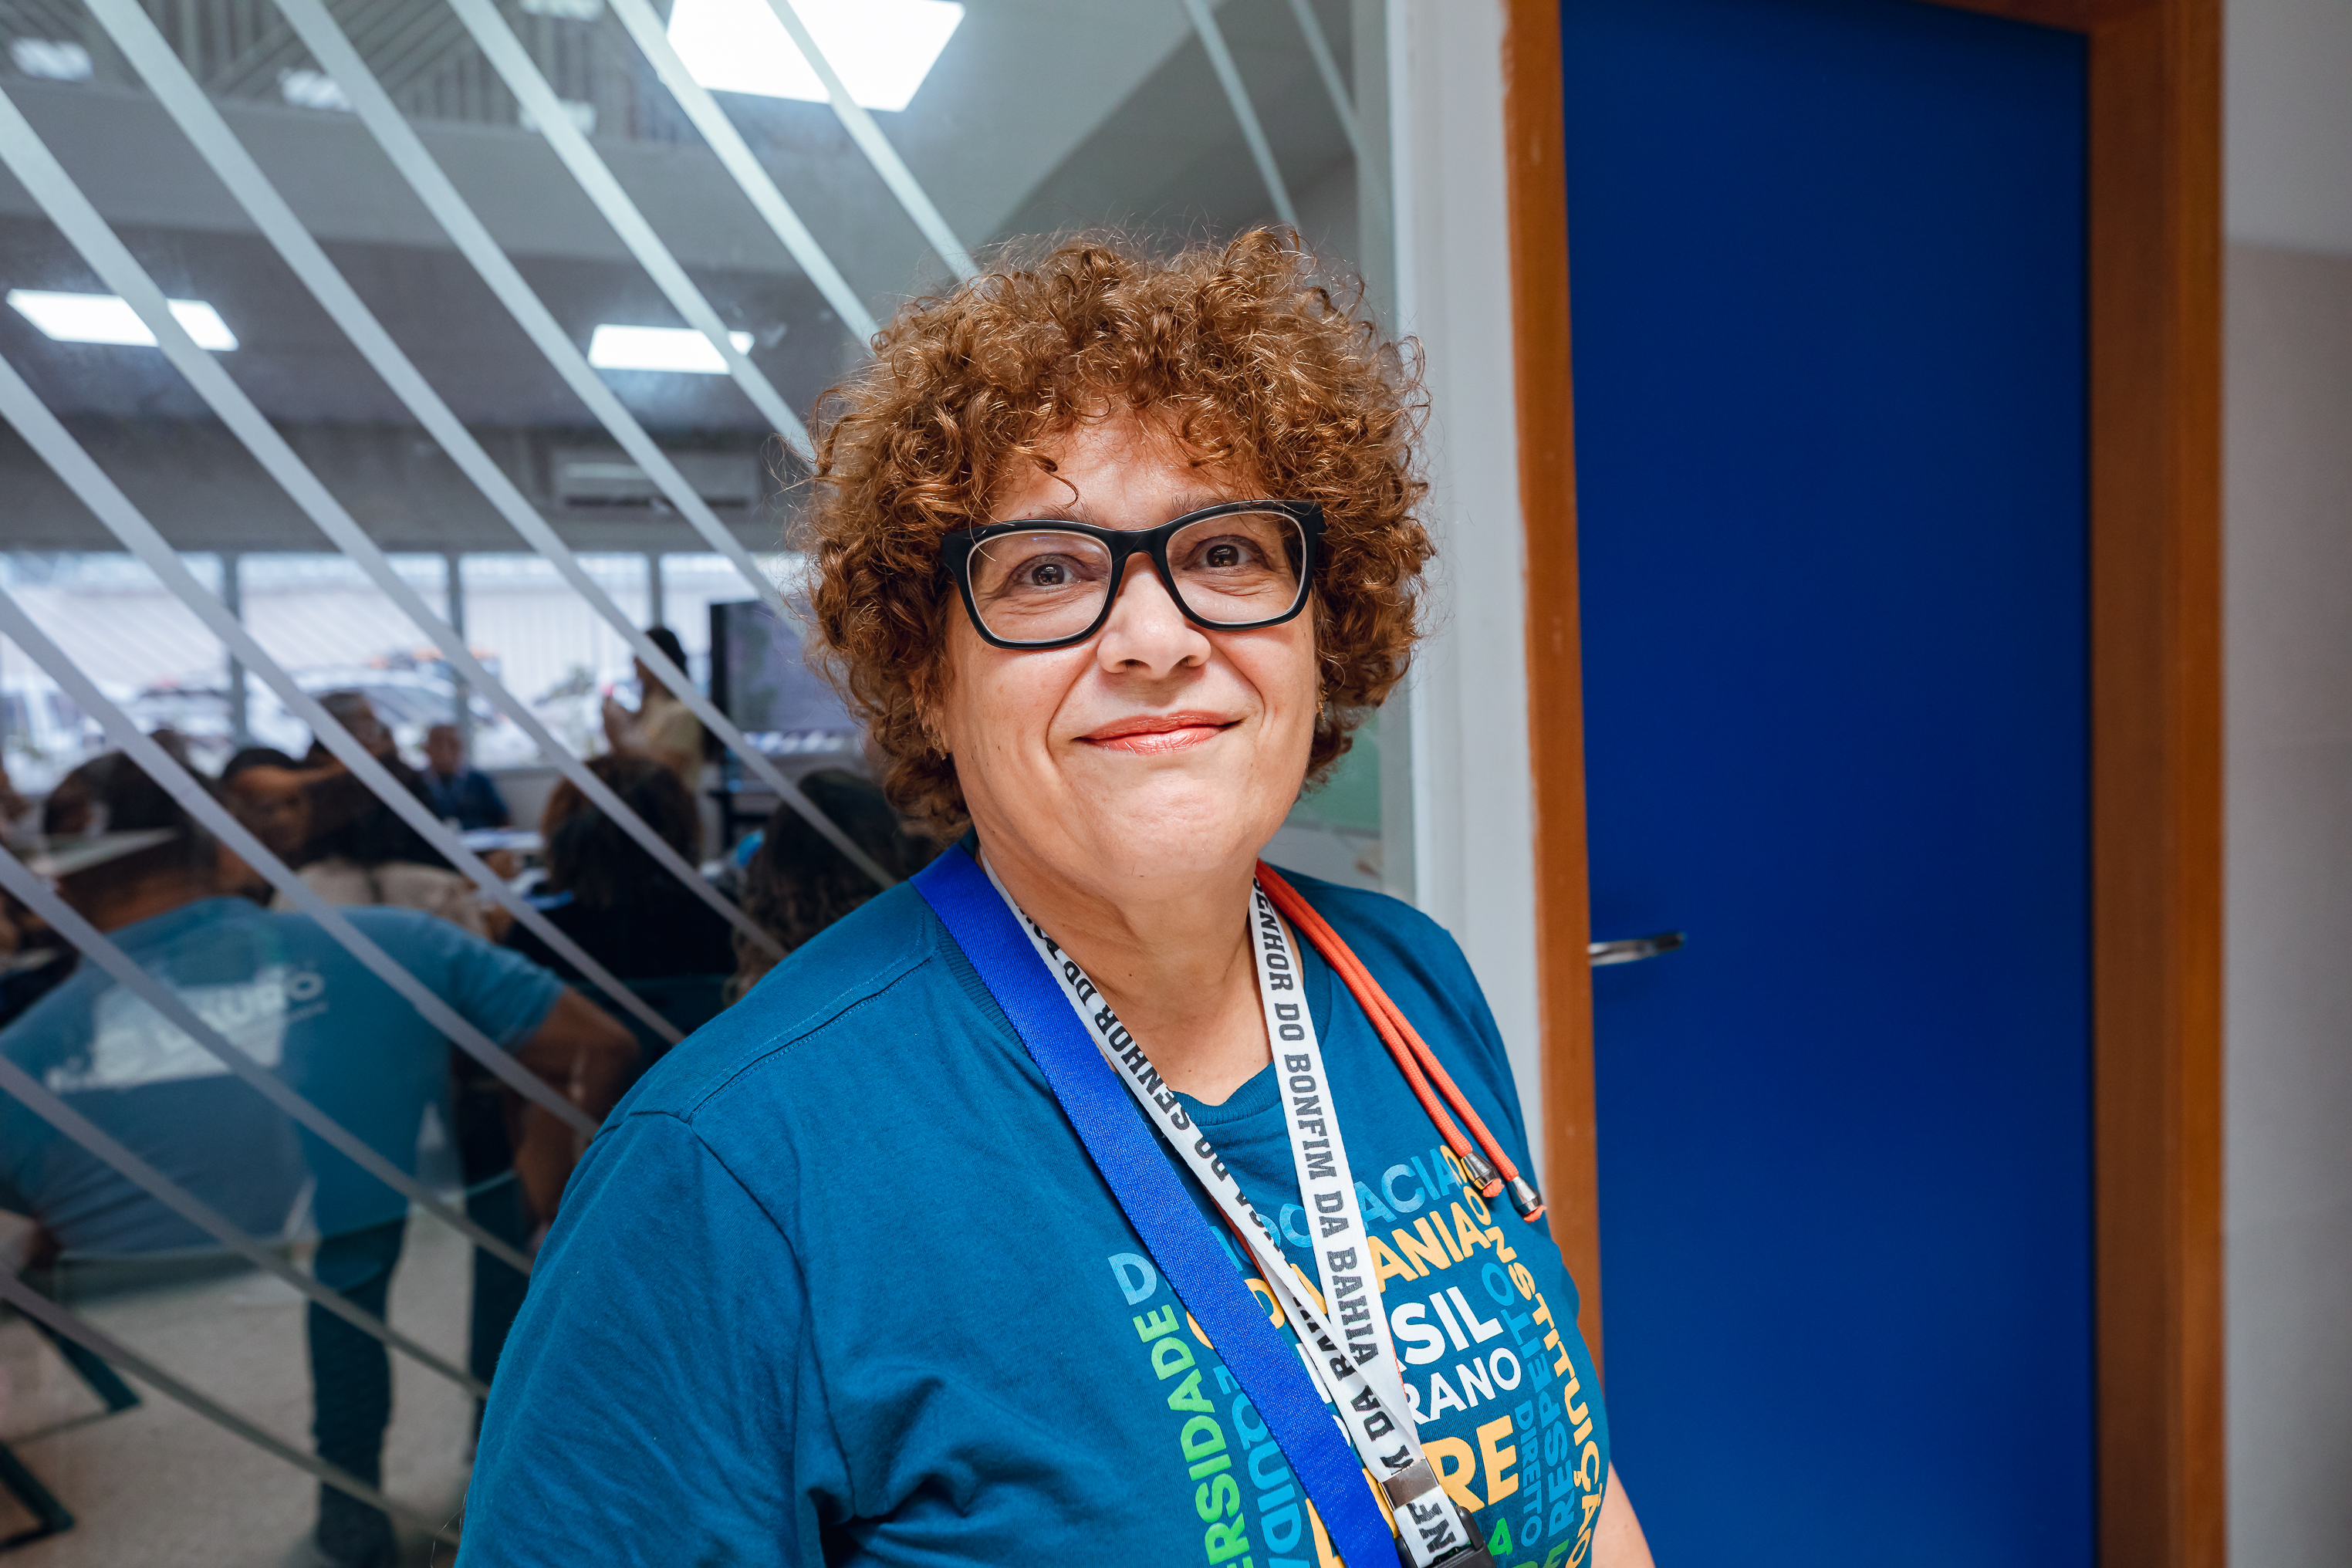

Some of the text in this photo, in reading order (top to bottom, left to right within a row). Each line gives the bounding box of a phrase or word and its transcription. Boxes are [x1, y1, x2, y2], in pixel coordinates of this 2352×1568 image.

[1094, 1004, 1190, 1130] SENHOR
[1275, 1003, 1305, 1041] DO
[1284, 1053, 1337, 1180] BONFIM
[1314, 1191, 1349, 1238] DA
[1326, 1247, 1378, 1367] BAHIA
[1391, 1286, 1504, 1372] SIL
[1440, 1145, 1603, 1568] CONSTITUIÇÃO
[1350, 1384, 1395, 1442] DA
[1482, 1262, 1574, 1537] RESPEITO
[1213, 1364, 1309, 1568] QUID
[1515, 1400, 1542, 1546] DIREITO
